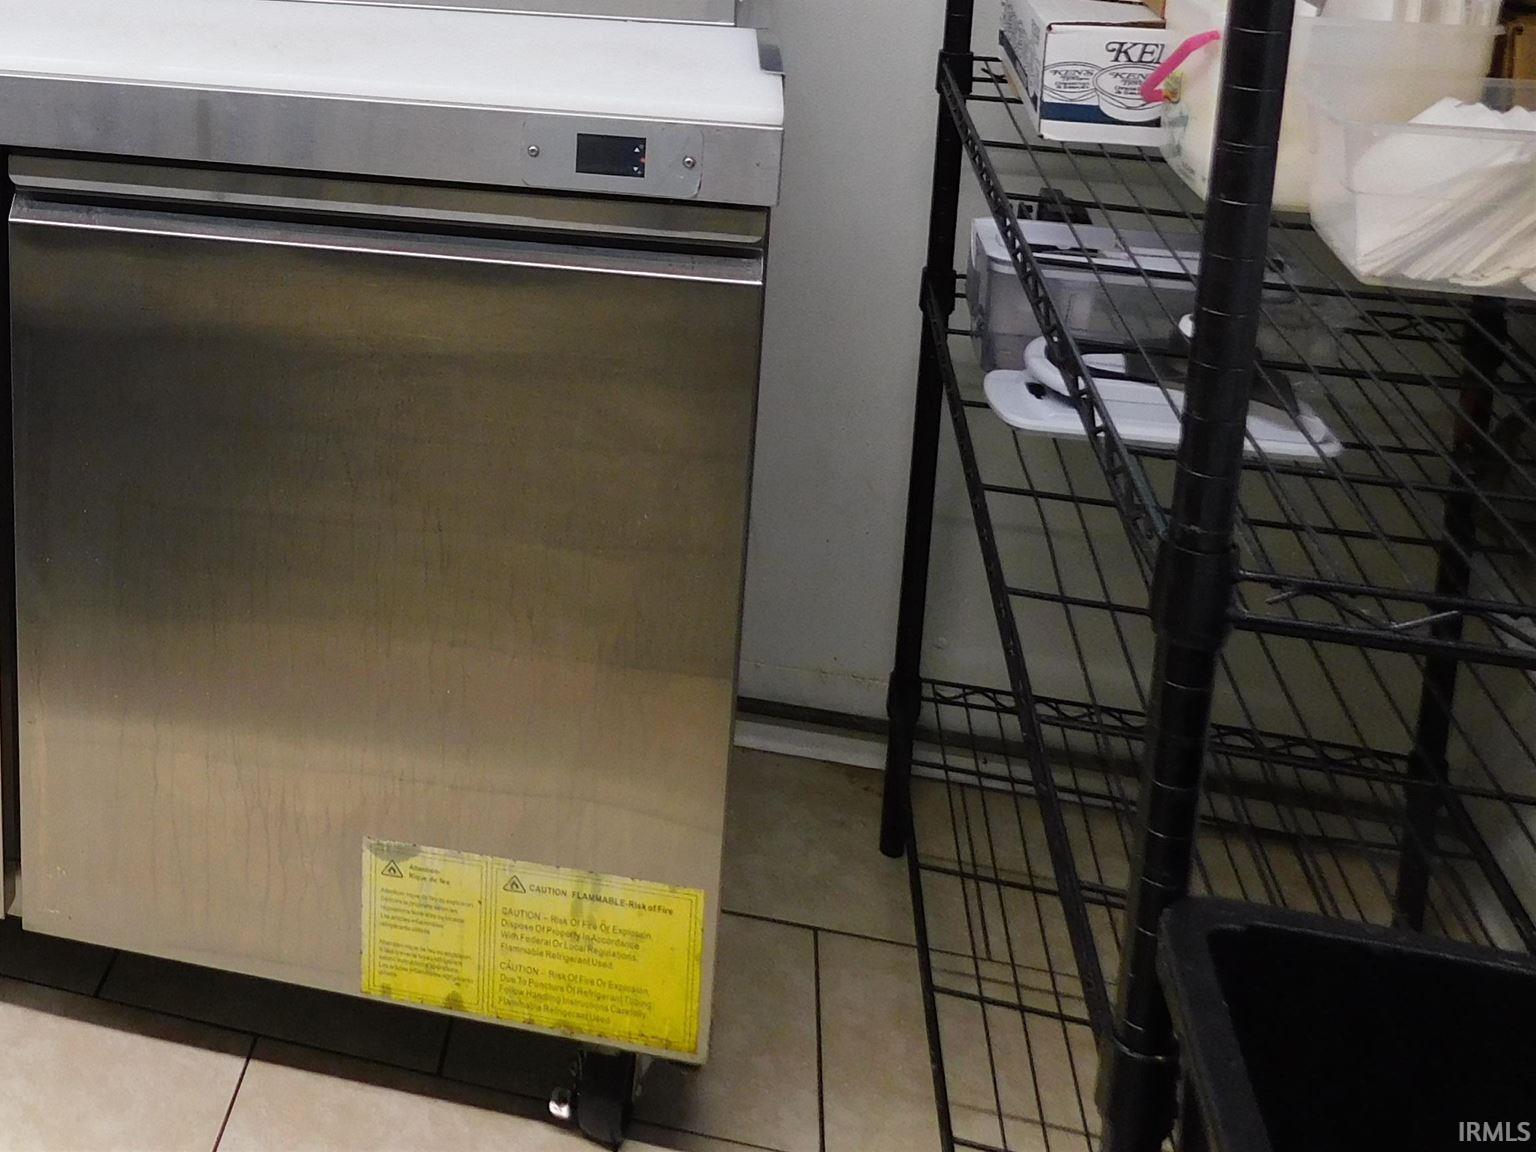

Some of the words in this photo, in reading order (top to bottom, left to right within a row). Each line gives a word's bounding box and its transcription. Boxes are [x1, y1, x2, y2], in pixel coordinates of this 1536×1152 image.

[529, 884, 567, 897] CAUTION
[657, 905, 674, 915] Fire
[501, 907, 541, 921] CAUTION
[550, 915, 568, 926] Risk
[582, 920, 598, 930] Fire
[501, 918, 534, 931] Dispose
[501, 930, 519, 941] With
[520, 933, 552, 946] Federal
[499, 960, 539, 976] CAUTION
